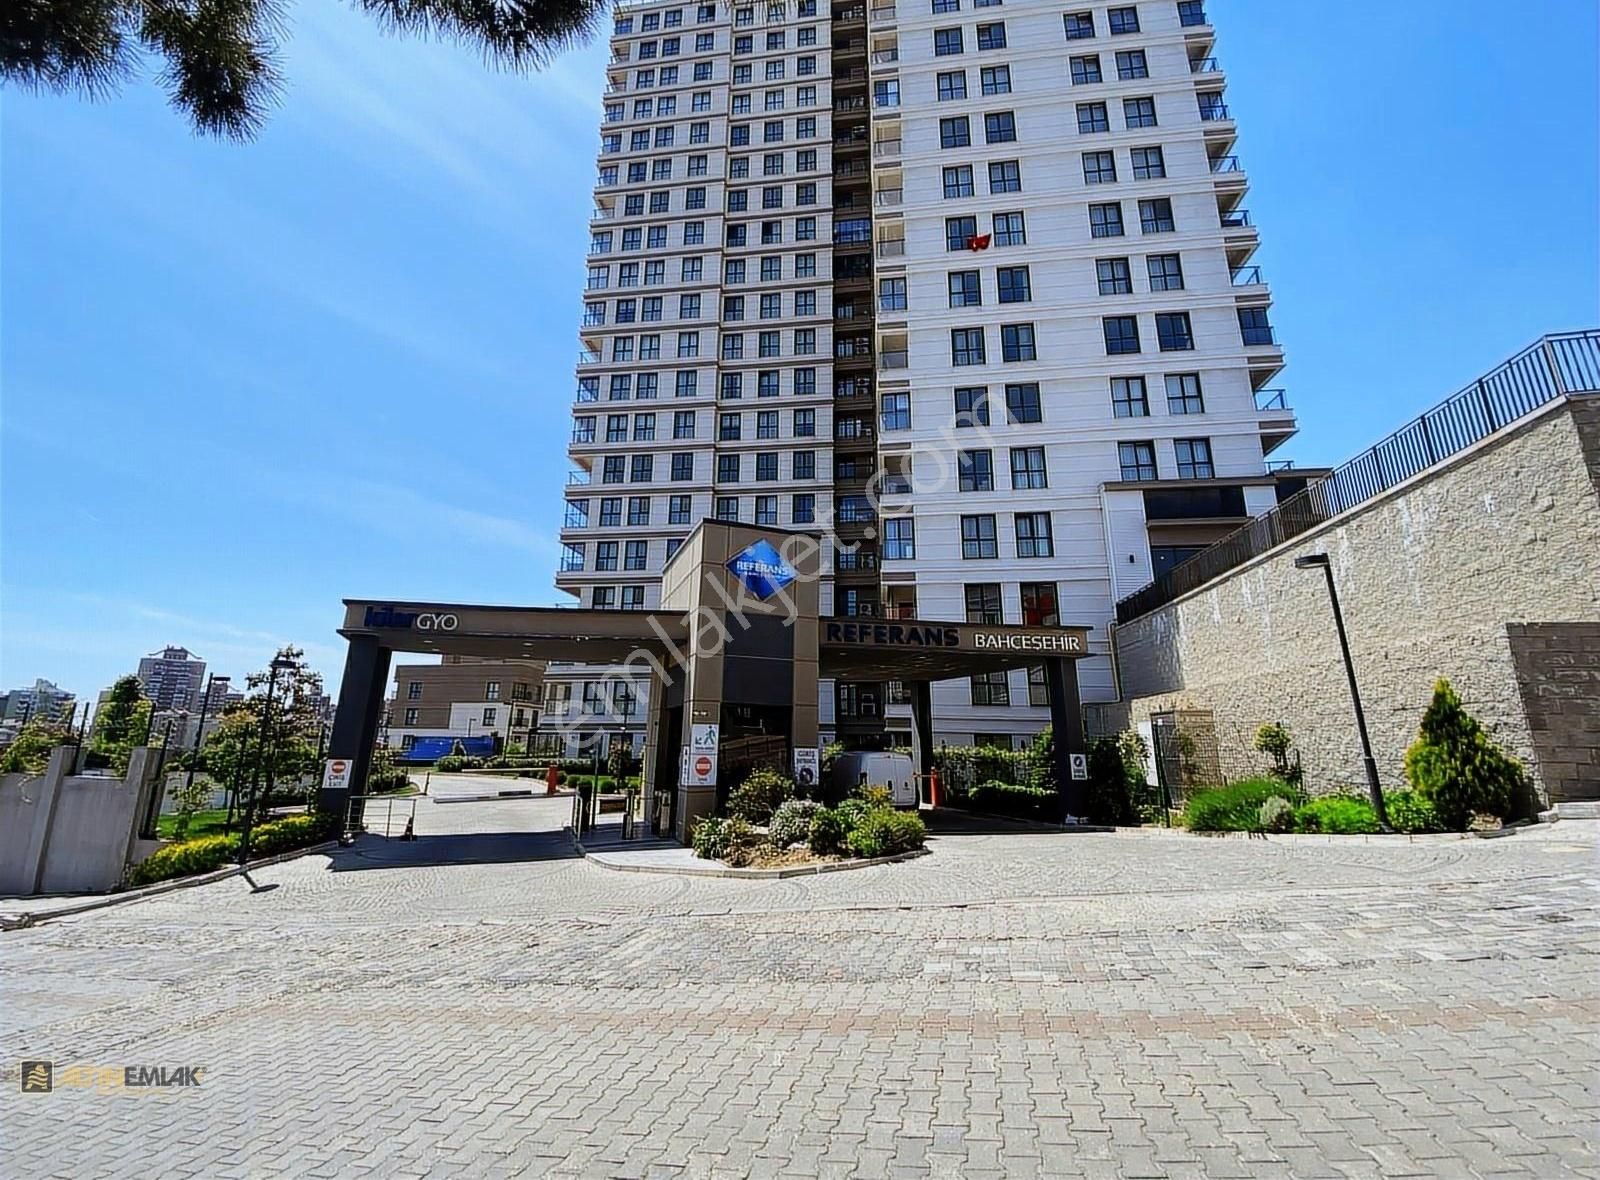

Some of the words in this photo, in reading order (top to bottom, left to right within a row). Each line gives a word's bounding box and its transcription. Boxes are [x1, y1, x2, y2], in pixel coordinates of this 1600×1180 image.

[736, 560, 789, 576] REFERANS
[416, 613, 458, 631] GYO
[827, 622, 960, 647] REFERANS
